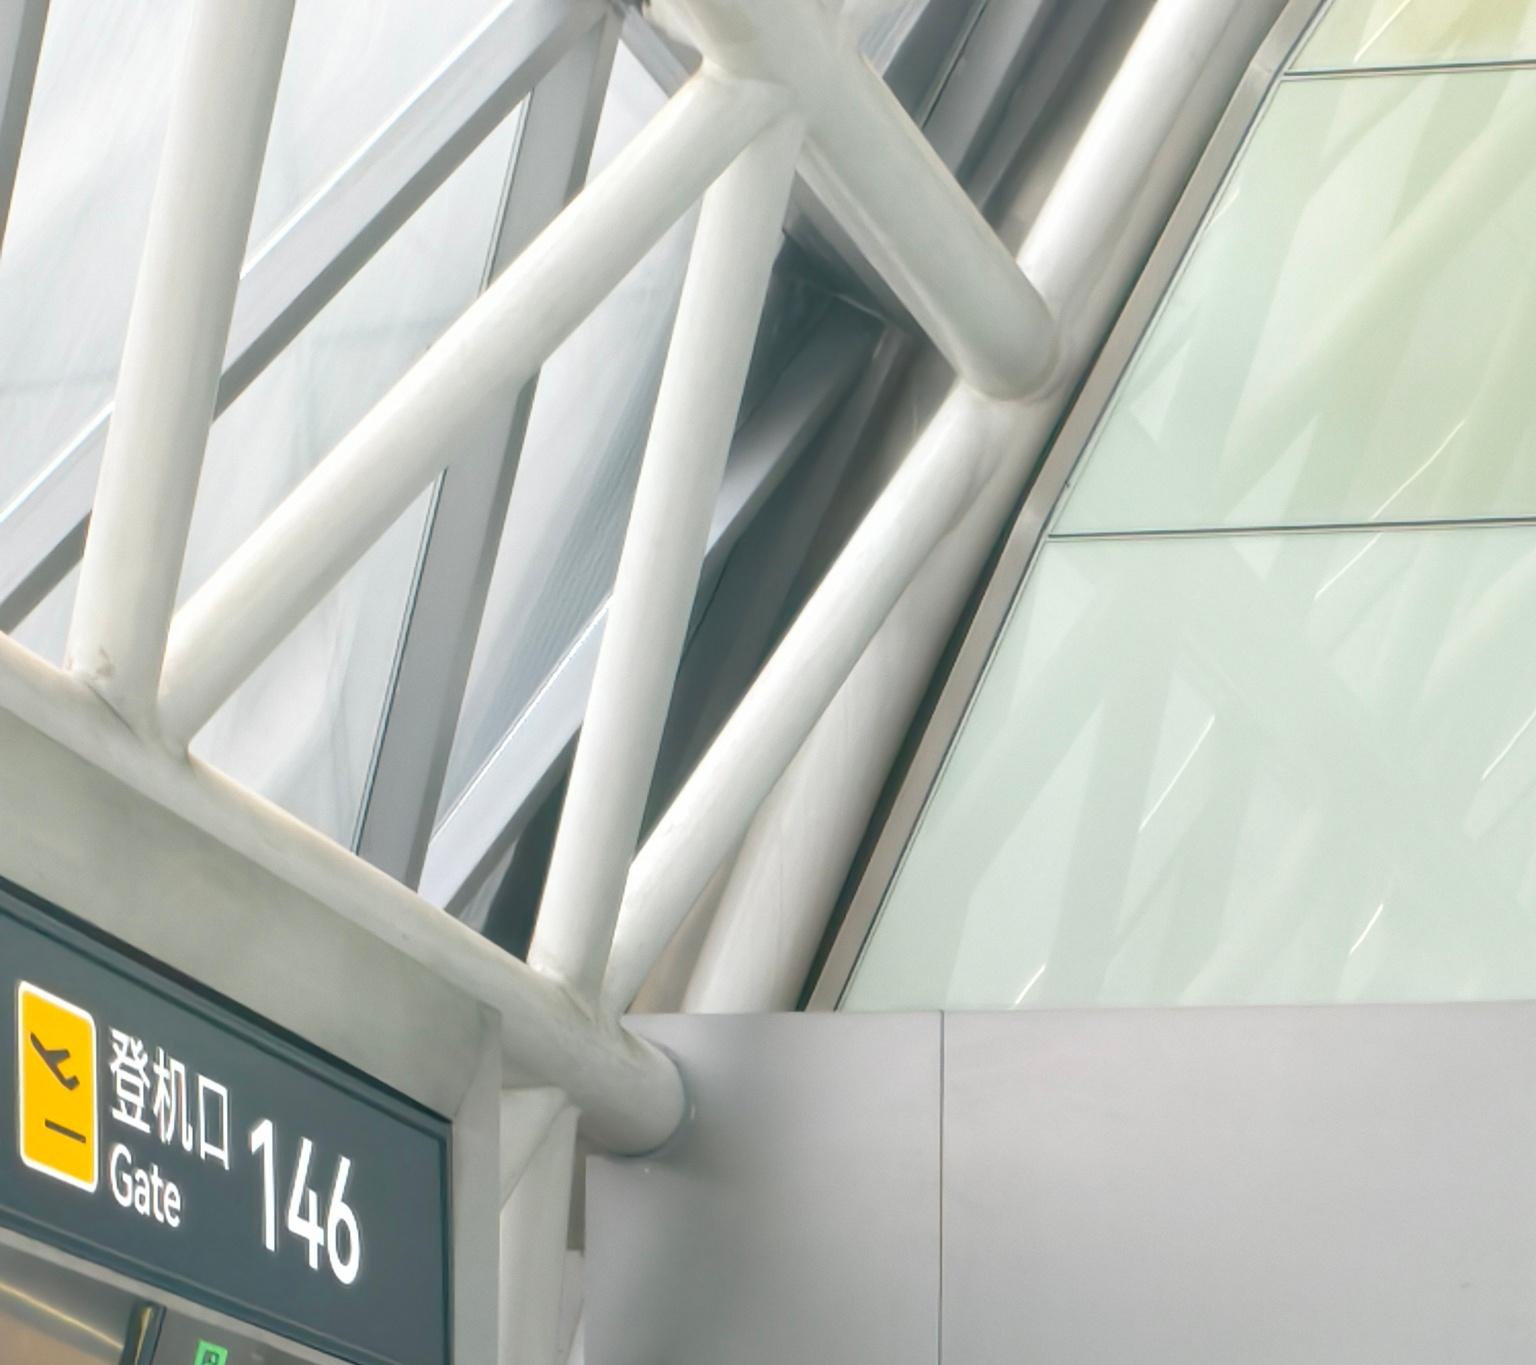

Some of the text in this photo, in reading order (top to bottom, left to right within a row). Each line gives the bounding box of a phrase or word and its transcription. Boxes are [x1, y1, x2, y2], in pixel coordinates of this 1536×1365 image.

[109, 1027, 230, 1170] 登机口
[109, 1144, 182, 1229] Gate
[250, 1119, 362, 1285] 146
